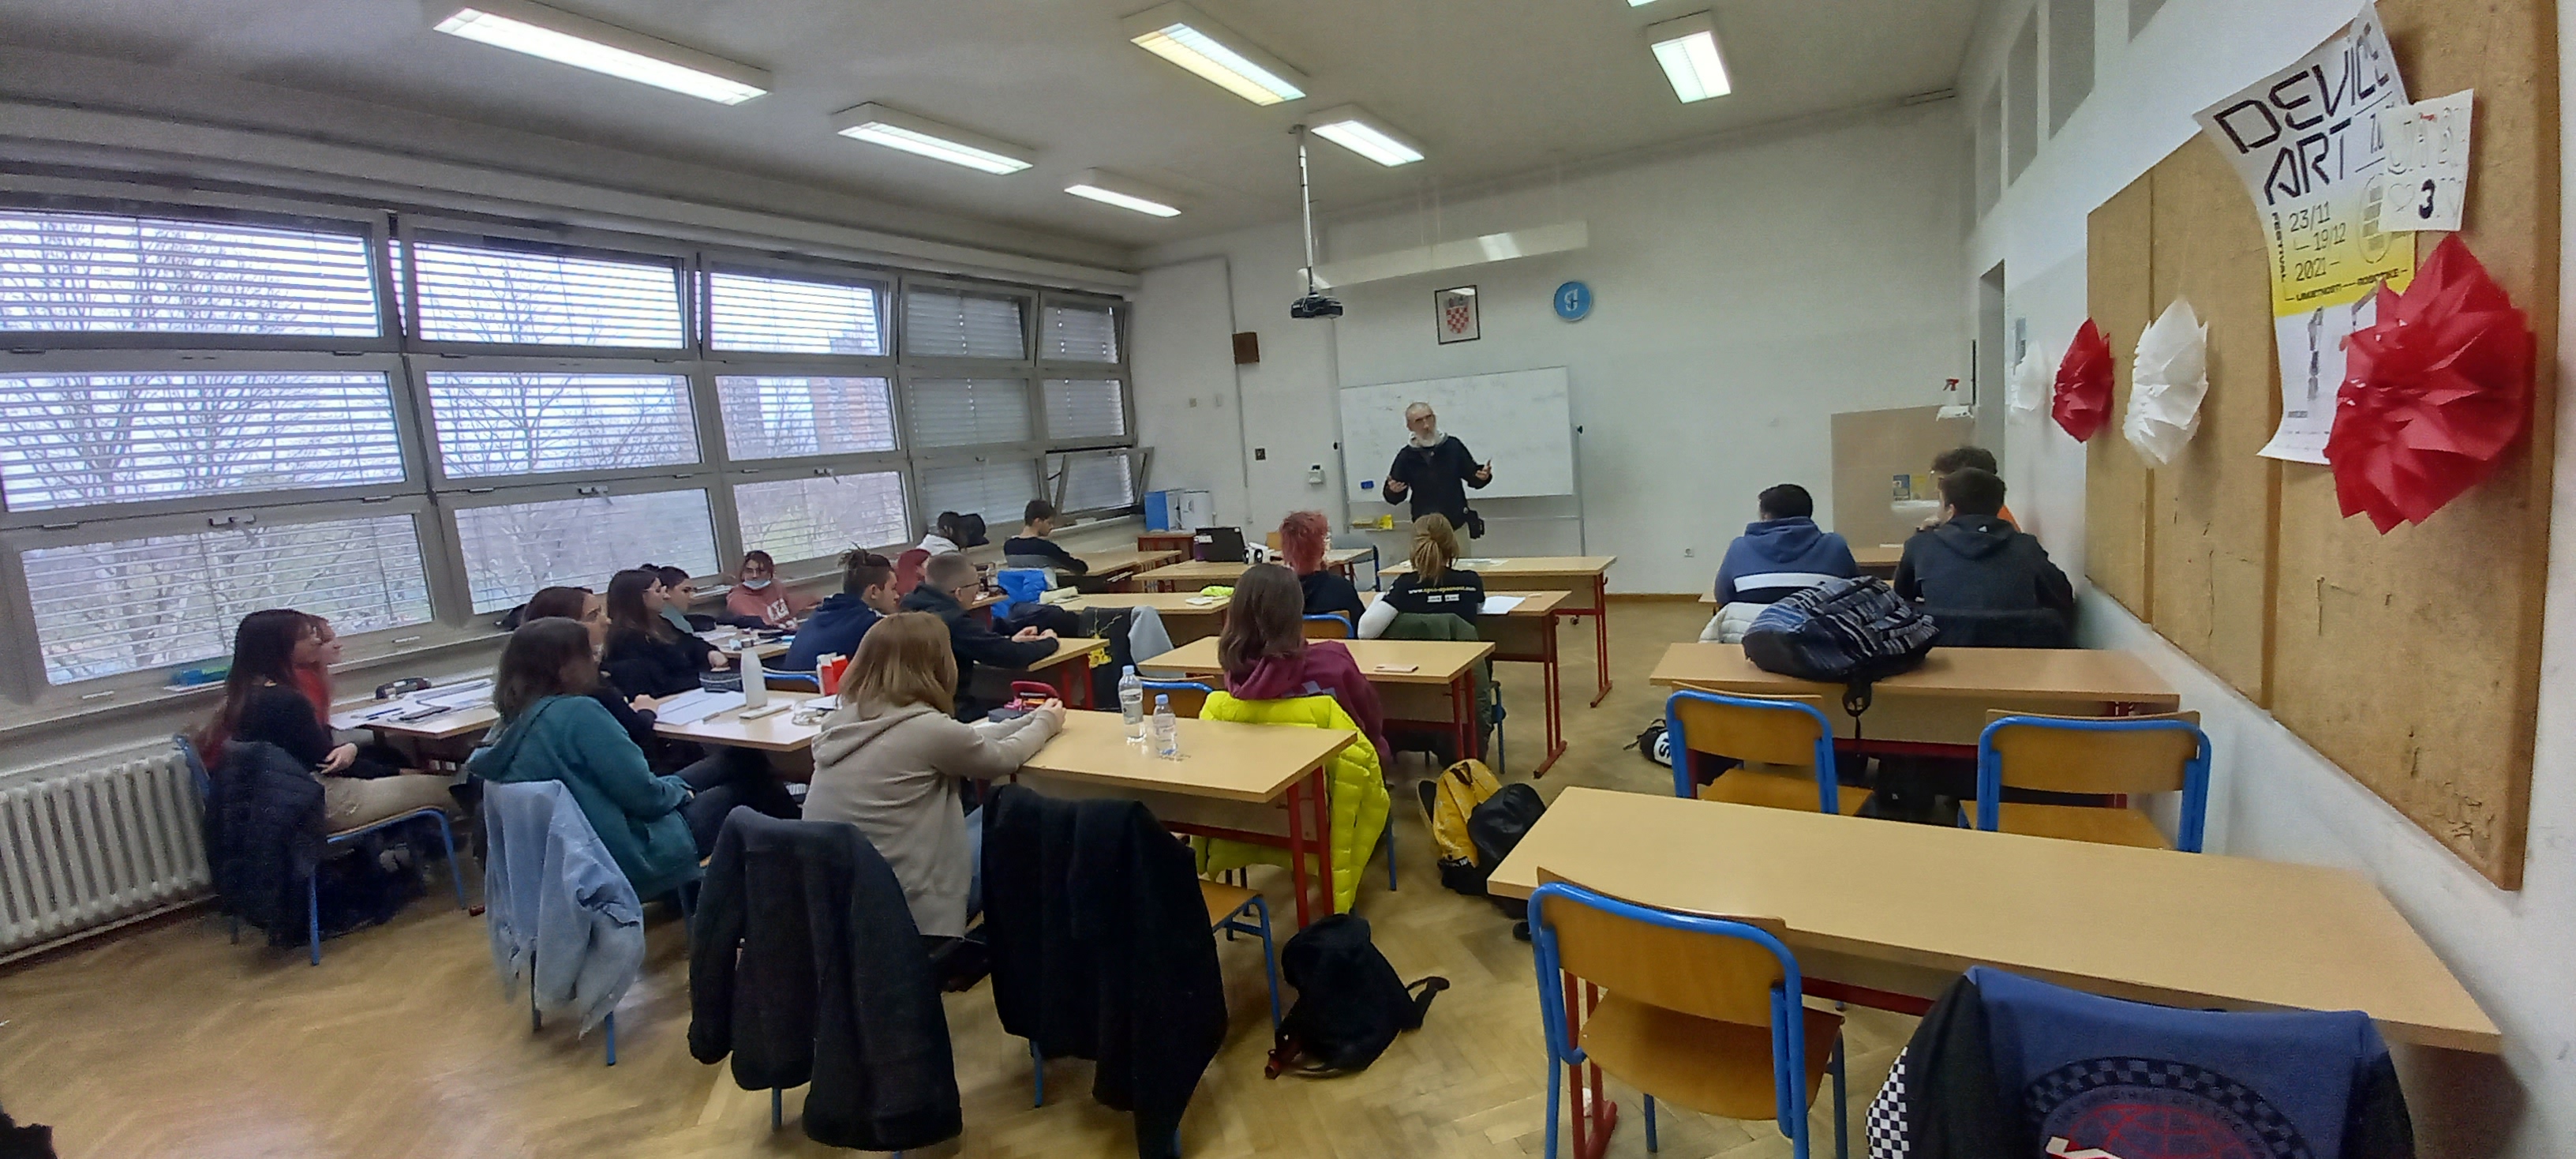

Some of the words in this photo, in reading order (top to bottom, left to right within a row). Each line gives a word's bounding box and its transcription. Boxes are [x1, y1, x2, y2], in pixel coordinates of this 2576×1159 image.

[2263, 118, 2352, 206] ART
[2289, 201, 2331, 232] 23/11
[2271, 212, 2287, 283] FESTIVAL
[2313, 222, 2346, 251] 19/12
[2295, 257, 2327, 282] 2021
